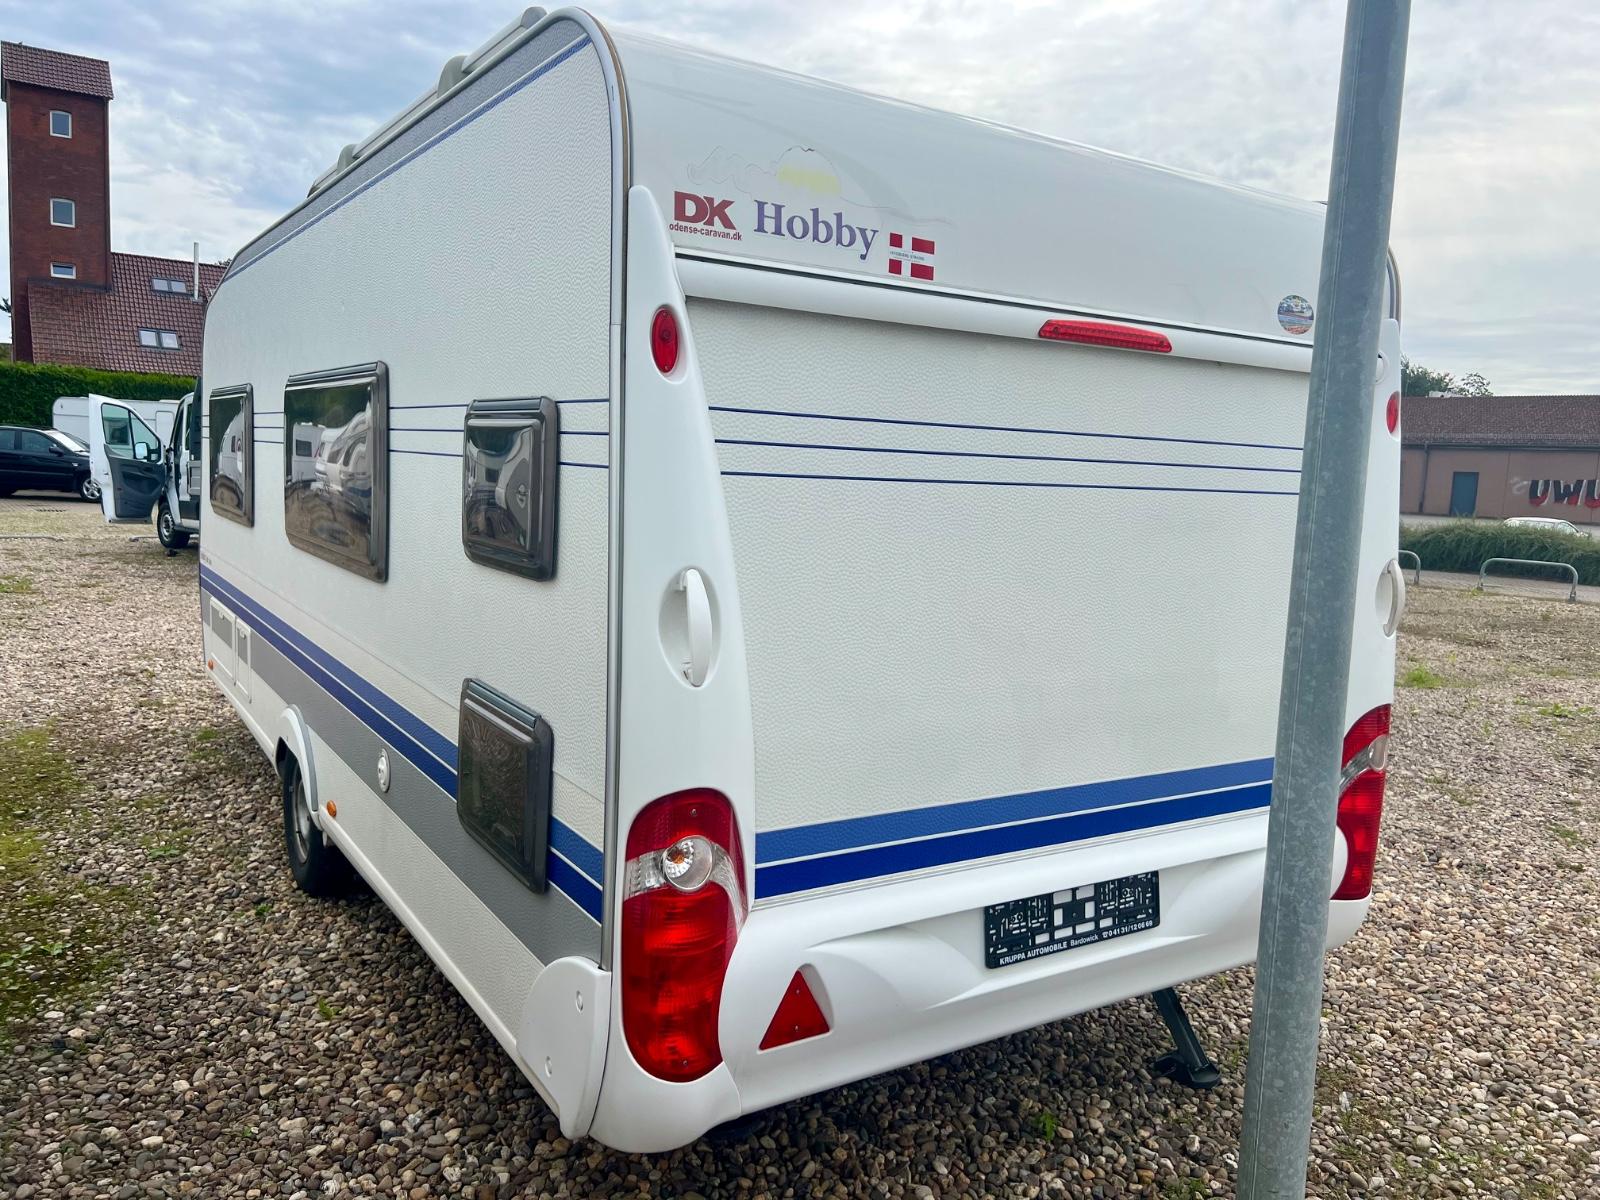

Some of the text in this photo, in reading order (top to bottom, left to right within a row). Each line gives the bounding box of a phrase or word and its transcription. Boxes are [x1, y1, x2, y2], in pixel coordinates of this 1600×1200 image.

[674, 191, 736, 230] DK
[669, 222, 742, 240] odense-caravan.dk
[754, 200, 879, 260] Hobby
[999, 952, 1026, 965] KRUPPA
[1027, 941, 1068, 958] AUTOMOBILE
[1070, 934, 1099, 947] Bardowick
